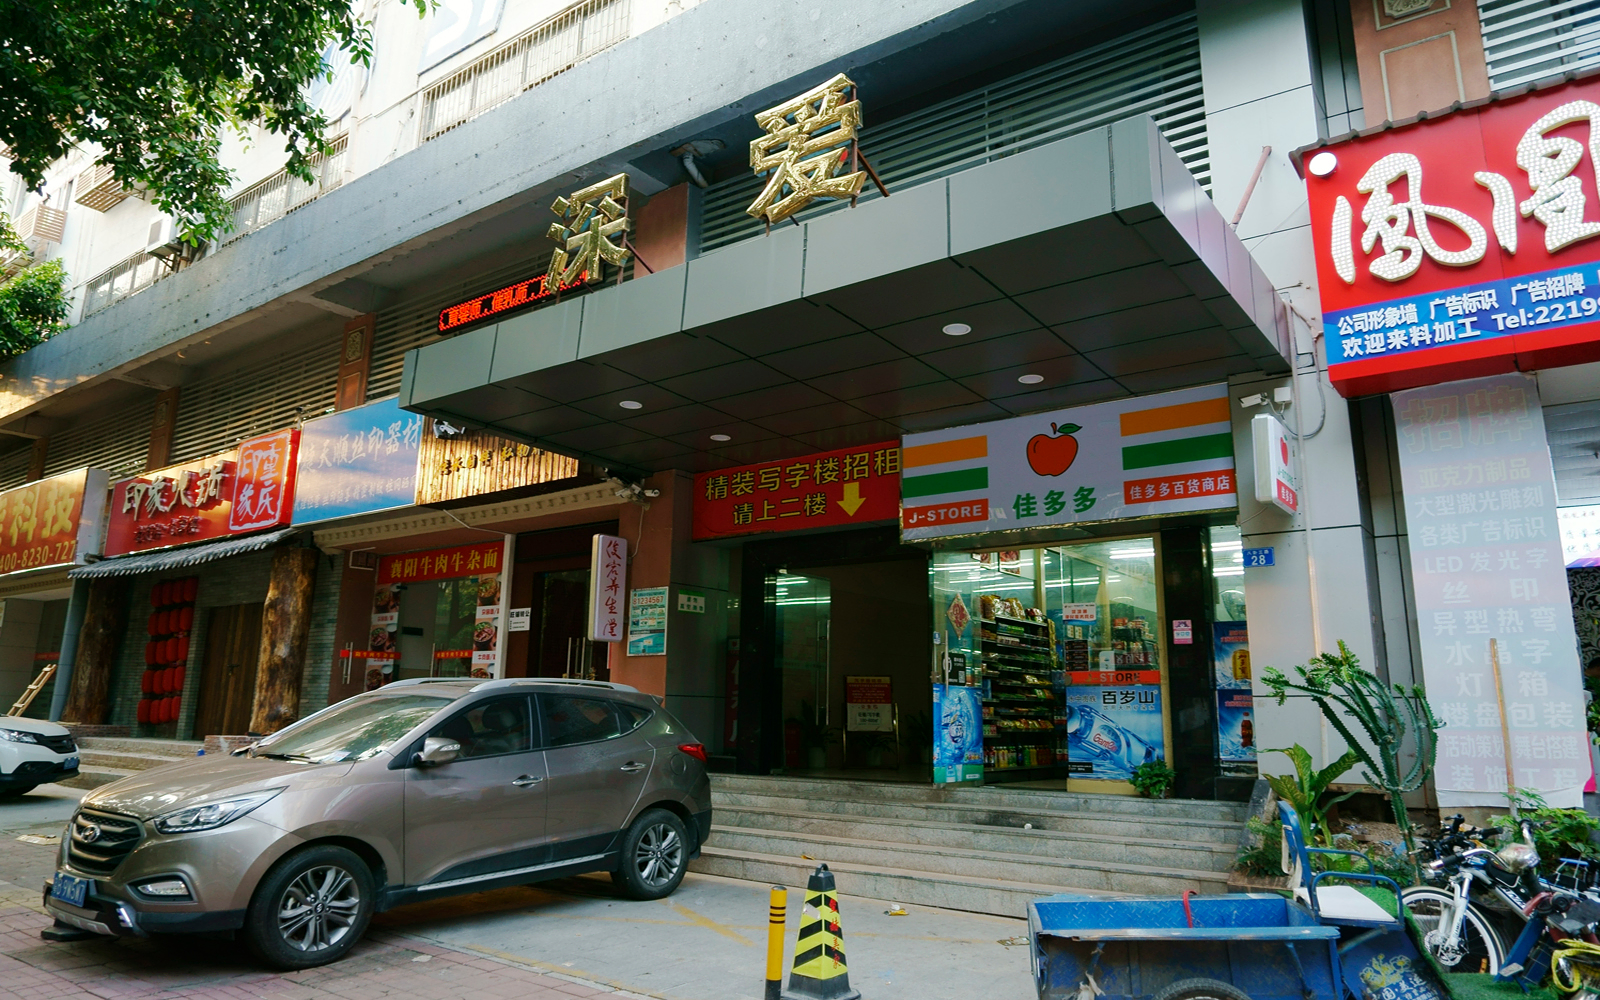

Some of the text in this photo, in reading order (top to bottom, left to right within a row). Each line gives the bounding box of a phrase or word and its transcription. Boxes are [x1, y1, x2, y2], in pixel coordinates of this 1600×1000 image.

[1337, 303, 1418, 336] 公司形象墙
[1429, 289, 1499, 320] 广告标识
[1511, 272, 1586, 306] 广告招牌
[1341, 297, 1600, 358] 欢迎来料加工 Tel:2219
[1402, 385, 1533, 454] 招牌
[704, 447, 899, 501] 精装写字楼招租
[1129, 475, 1230, 500] 佳多多百货商店
[1418, 458, 1531, 490] 亚克力制品
[0, 481, 76, 547] 科技
[733, 492, 827, 525] 请上二楼
[909, 504, 982, 523] J-STORE
[1012, 486, 1097, 519] 佳多多
[1414, 485, 1544, 518] 大型激光雕刻
[1419, 516, 1547, 547] 各类广告标识
[390, 548, 498, 578] 襄阳牛肉牛杂面
[1251, 555, 1266, 566] 28
[1424, 556, 1463, 575] LED
[1470, 548, 1549, 572] 发光字
[1442, 577, 1540, 604] 丝印
[1433, 606, 1557, 636] 异型热弯
[1445, 638, 1552, 666] 水晶字
[1101, 690, 1154, 705] 百岁山
[1455, 670, 1549, 697] 灯箱
[1440, 701, 1575, 728] 楼盘包装
[1514, 735, 1580, 760] 舞台搭建
[1450, 764, 1579, 791] 装饰工程
